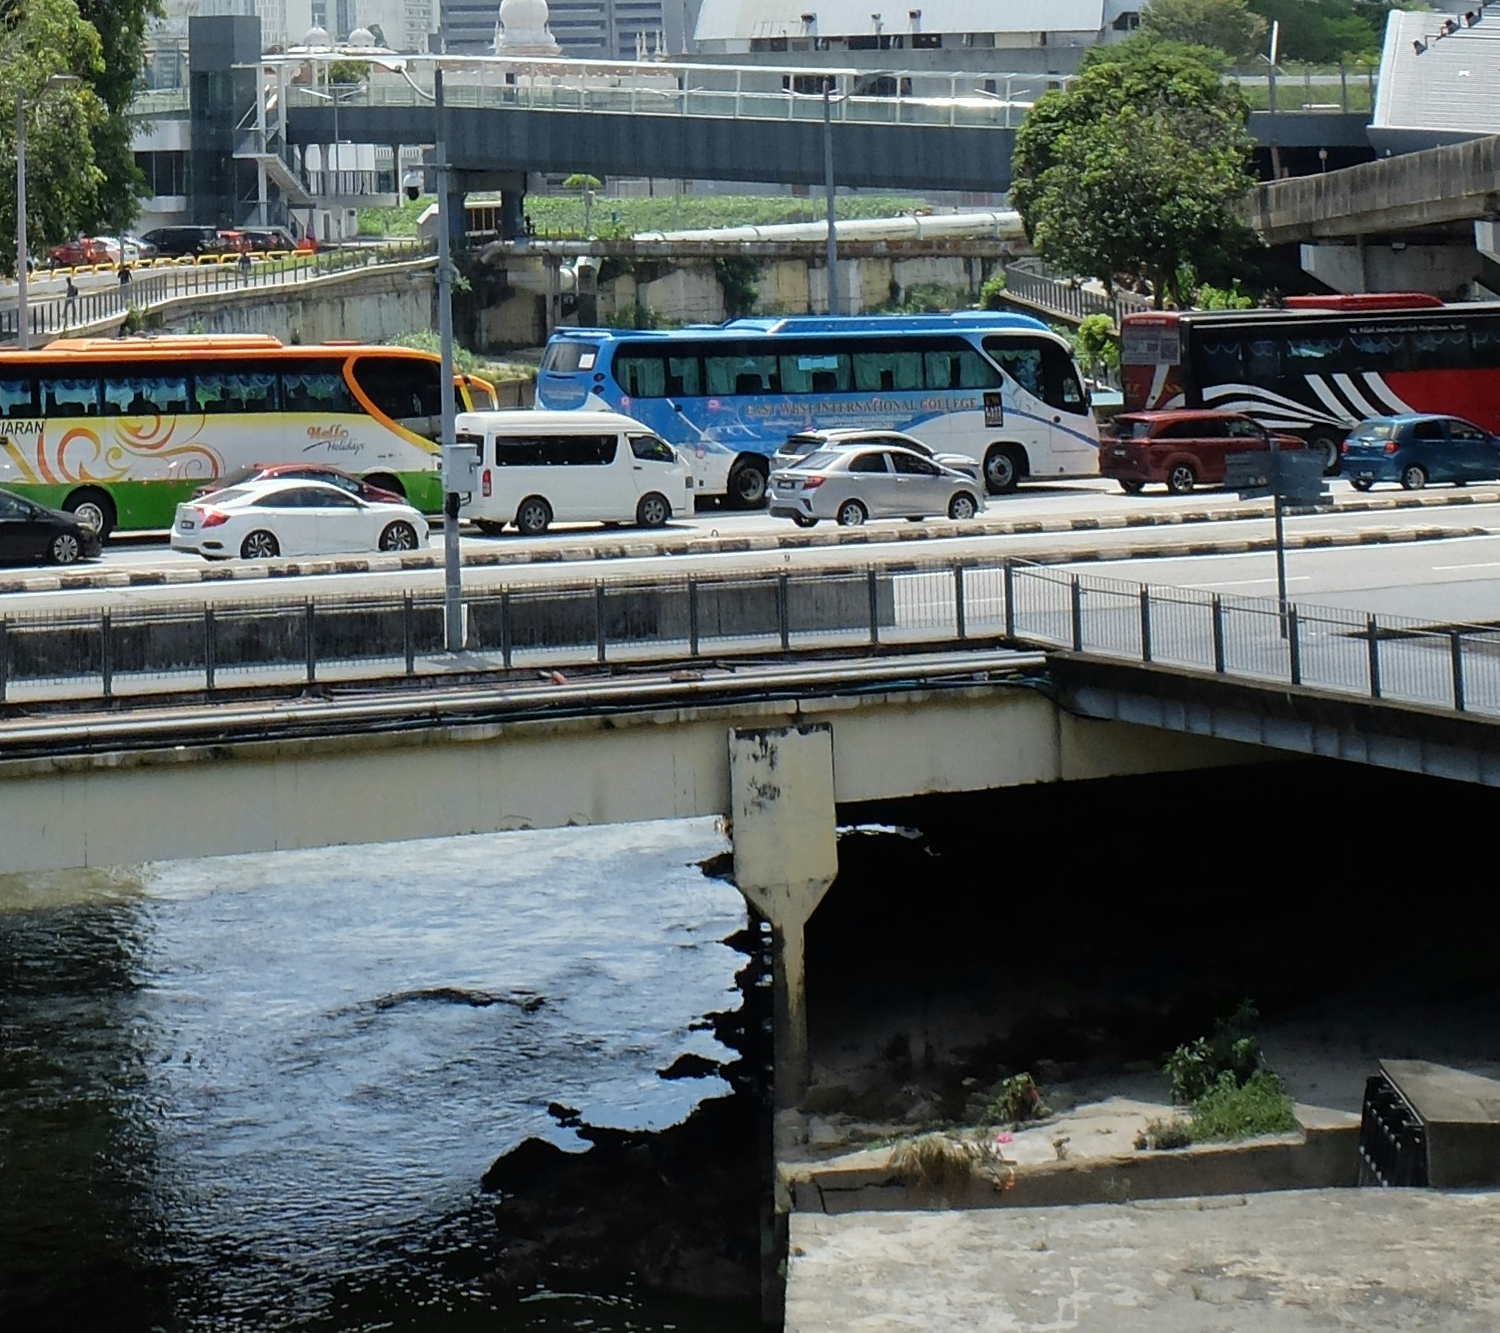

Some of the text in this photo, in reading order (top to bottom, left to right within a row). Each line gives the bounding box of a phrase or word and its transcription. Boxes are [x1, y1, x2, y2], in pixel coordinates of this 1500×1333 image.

[817, 399, 917, 414] INTERNATIONAL
[920, 397, 977, 411] COLLEGE
[306, 424, 349, 439] Hello
[326, 439, 365, 455] Holidays
